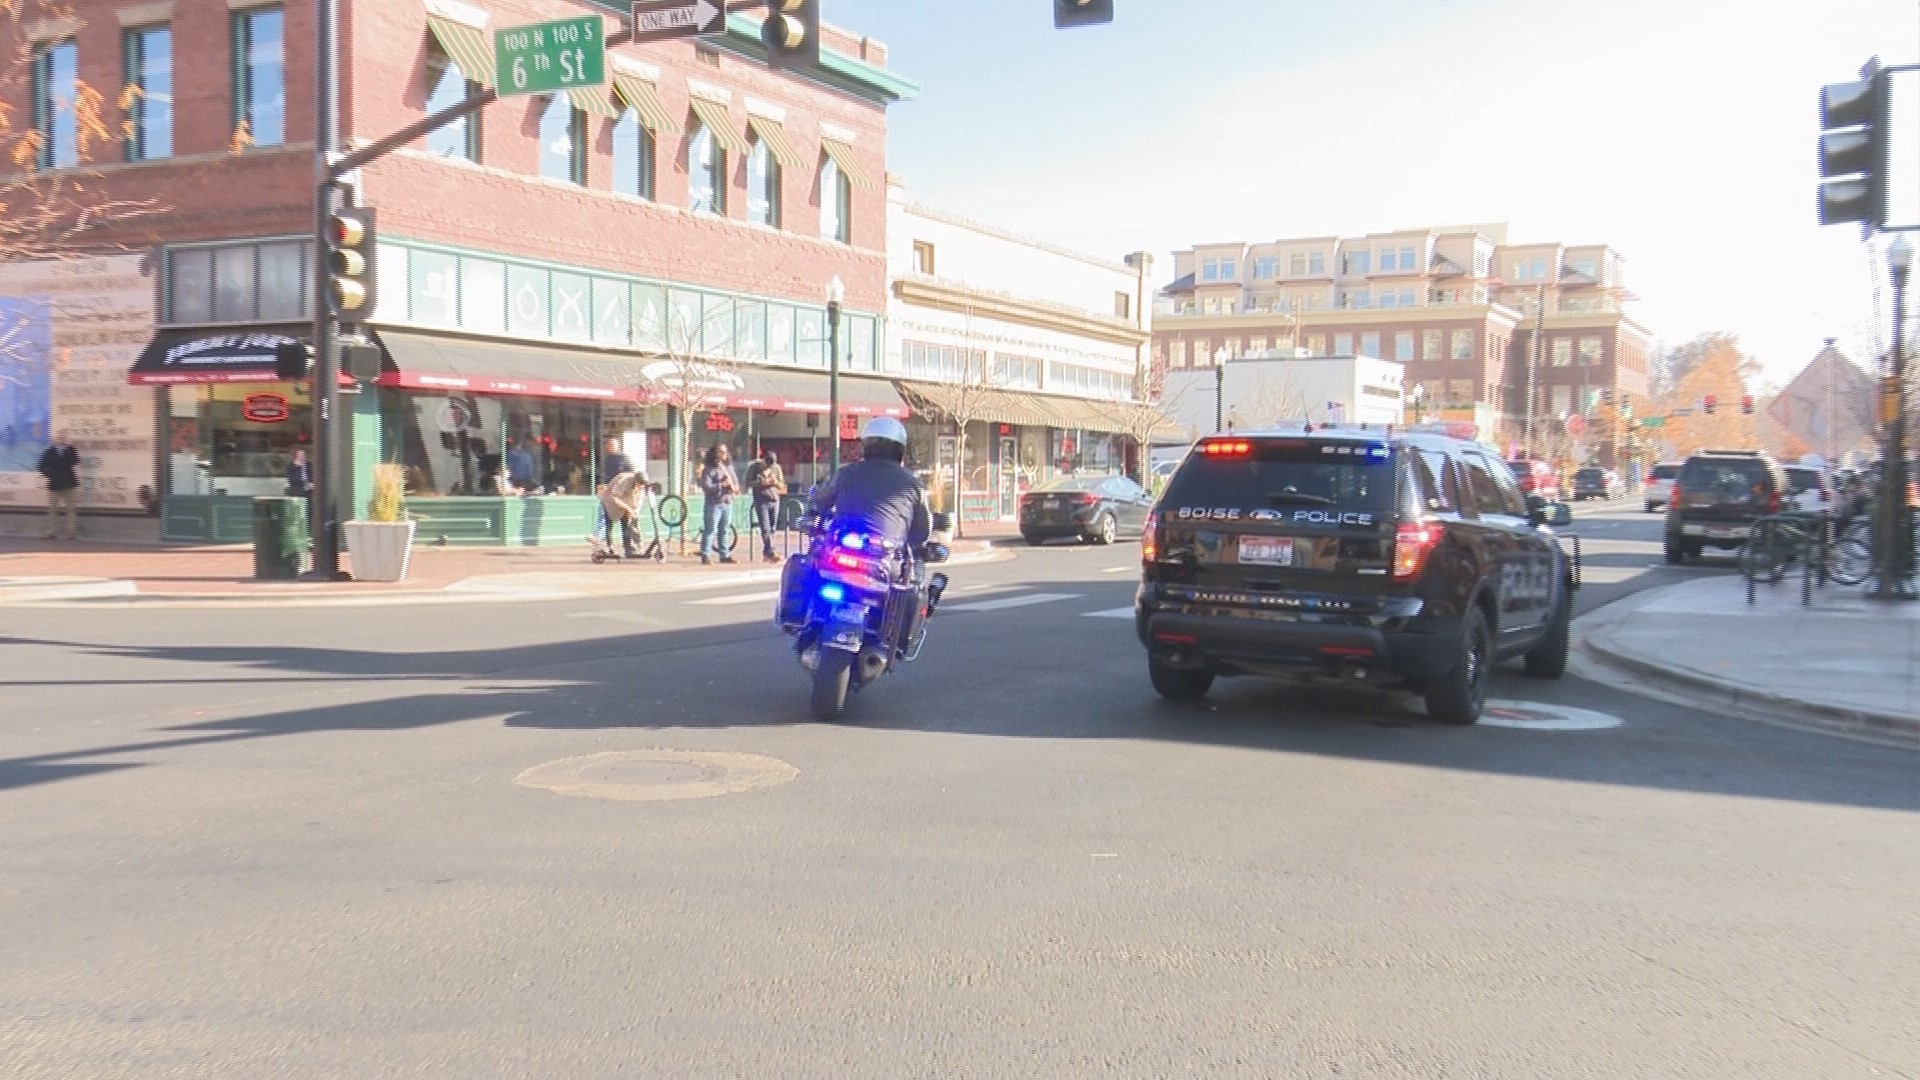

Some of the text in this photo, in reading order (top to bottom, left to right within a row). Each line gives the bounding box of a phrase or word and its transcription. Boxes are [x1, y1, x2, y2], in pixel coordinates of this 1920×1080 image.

[641, 7, 696, 30] ONE WAY
[503, 22, 593, 52] 100 N 100 S
[512, 48, 587, 89] 6 Th St
[1178, 507, 1241, 519] BOISE
[1292, 510, 1374, 526] POLICE
